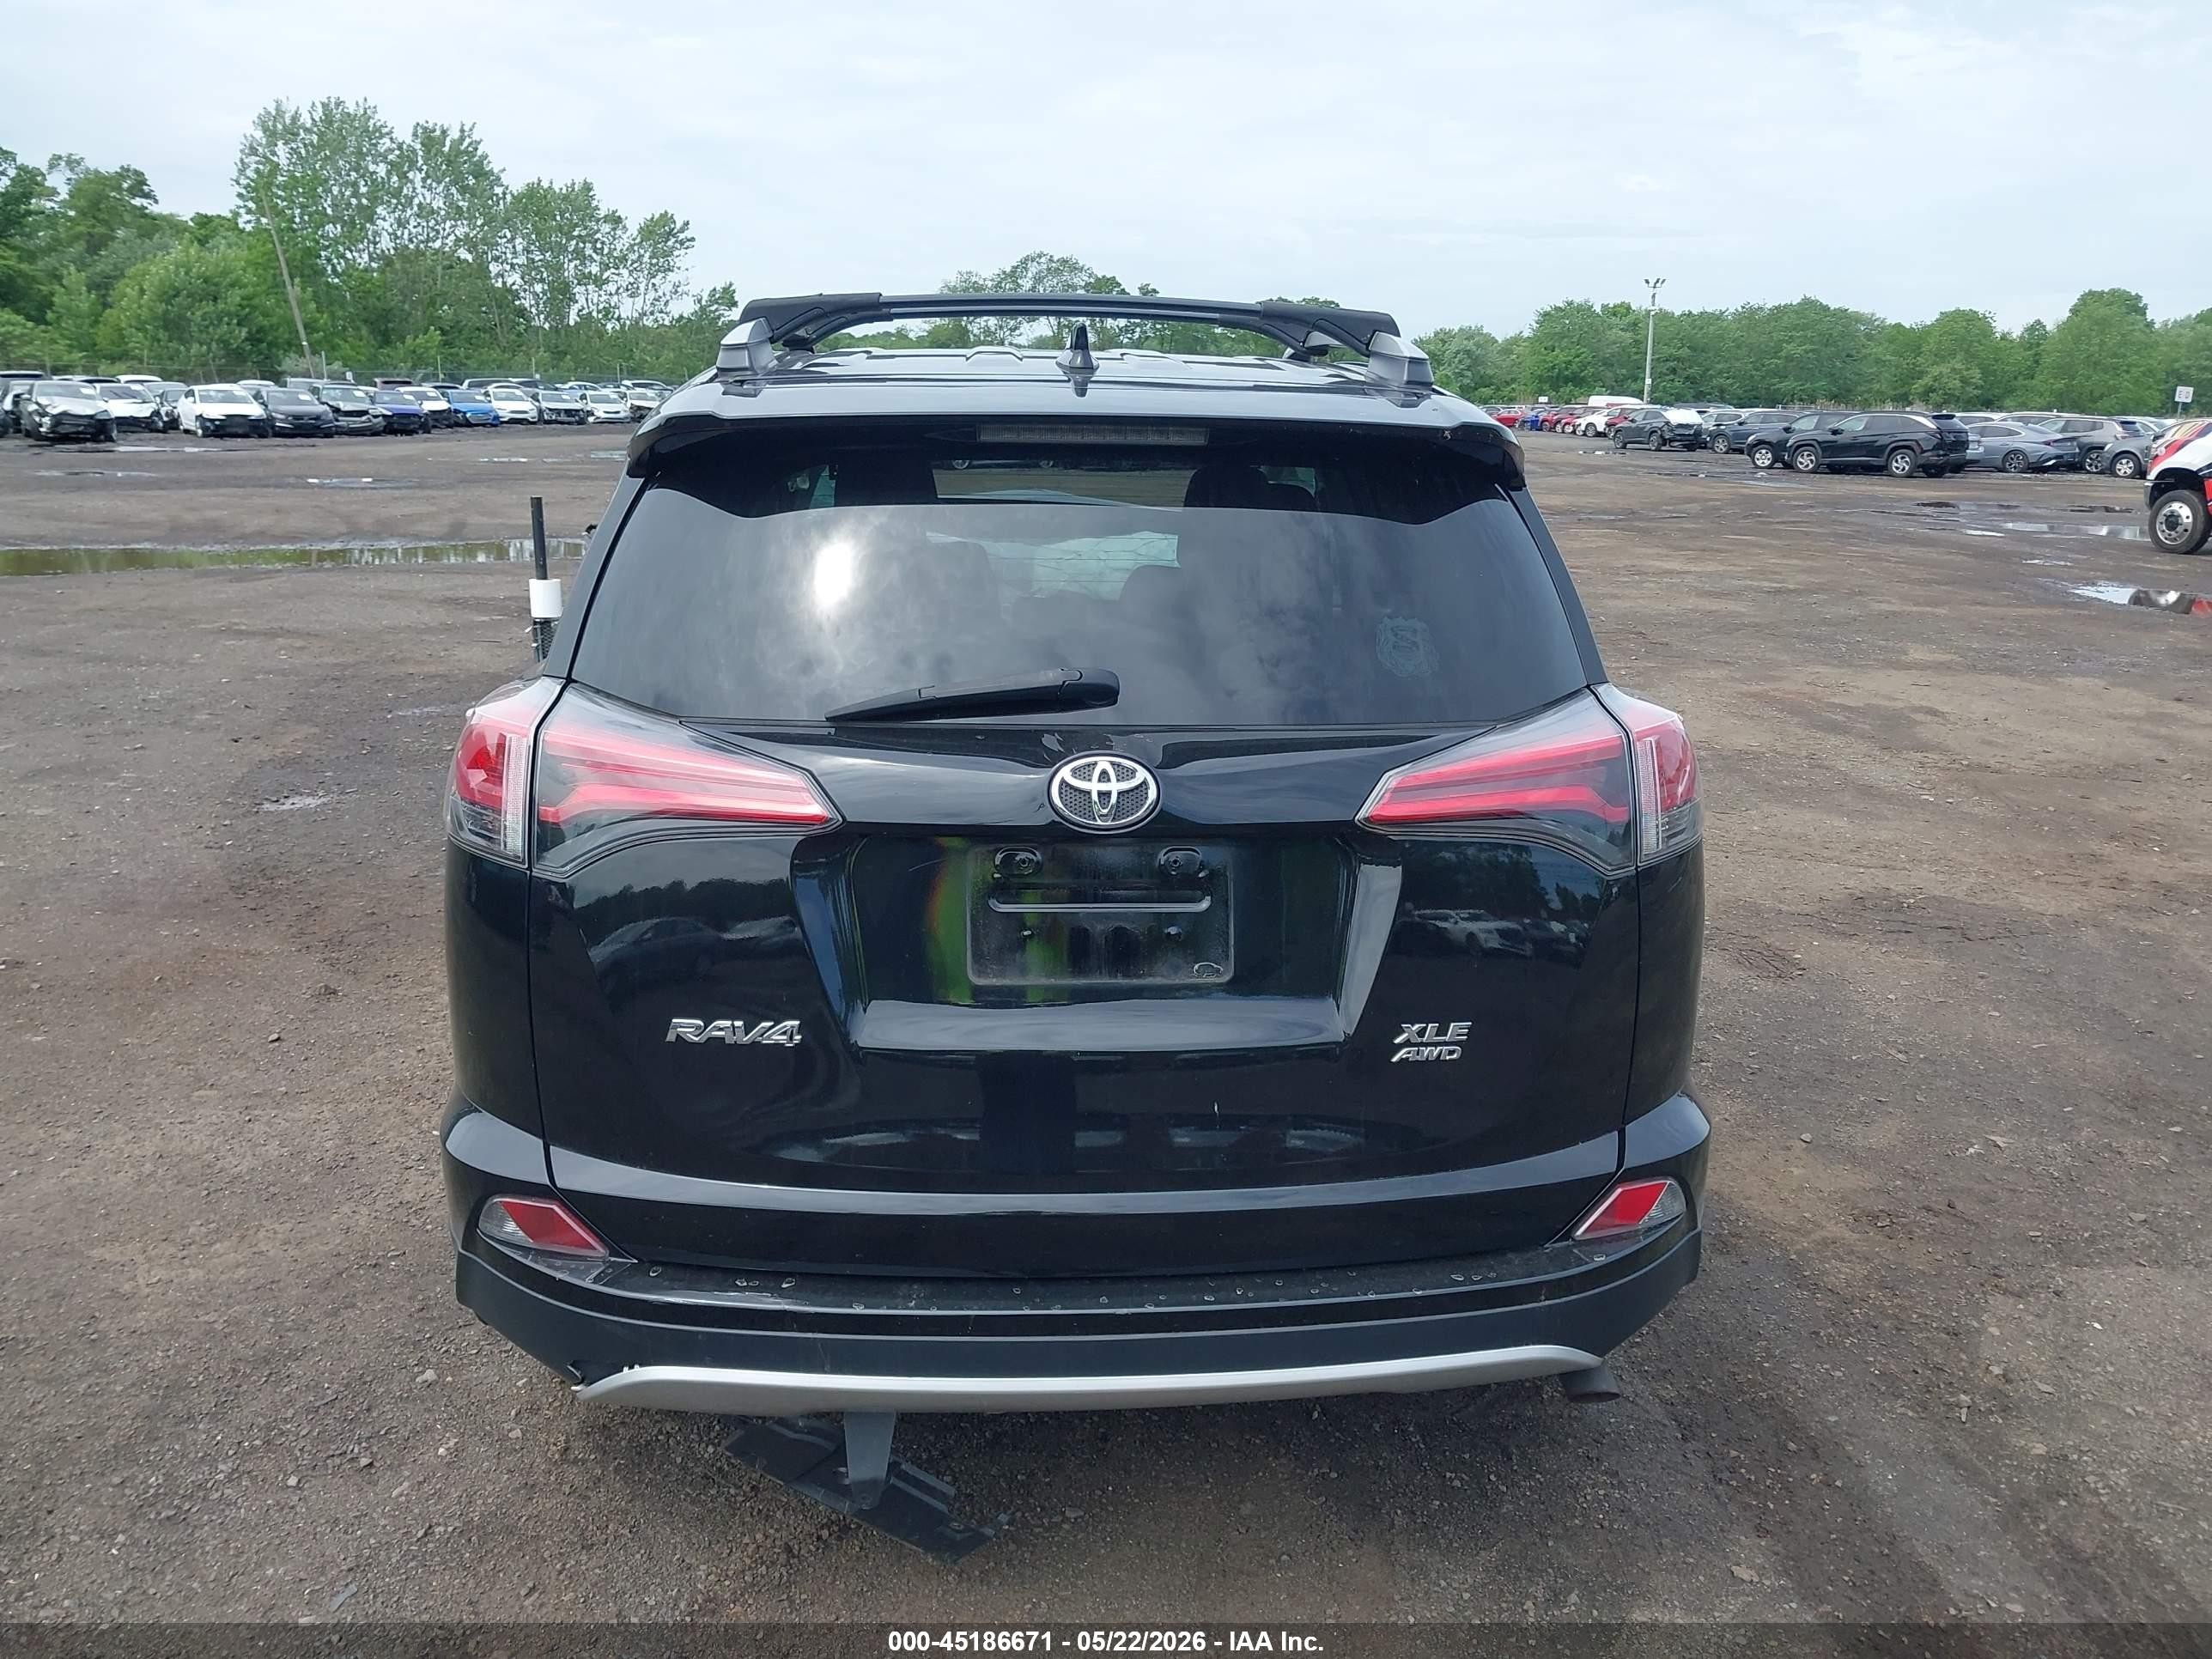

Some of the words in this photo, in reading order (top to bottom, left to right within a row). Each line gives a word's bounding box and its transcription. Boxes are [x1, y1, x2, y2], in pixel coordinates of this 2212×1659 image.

[665, 1017, 803, 1048] RAV4
[1393, 1021, 1473, 1044] XLE
[1390, 1045, 1462, 1063] AWD
